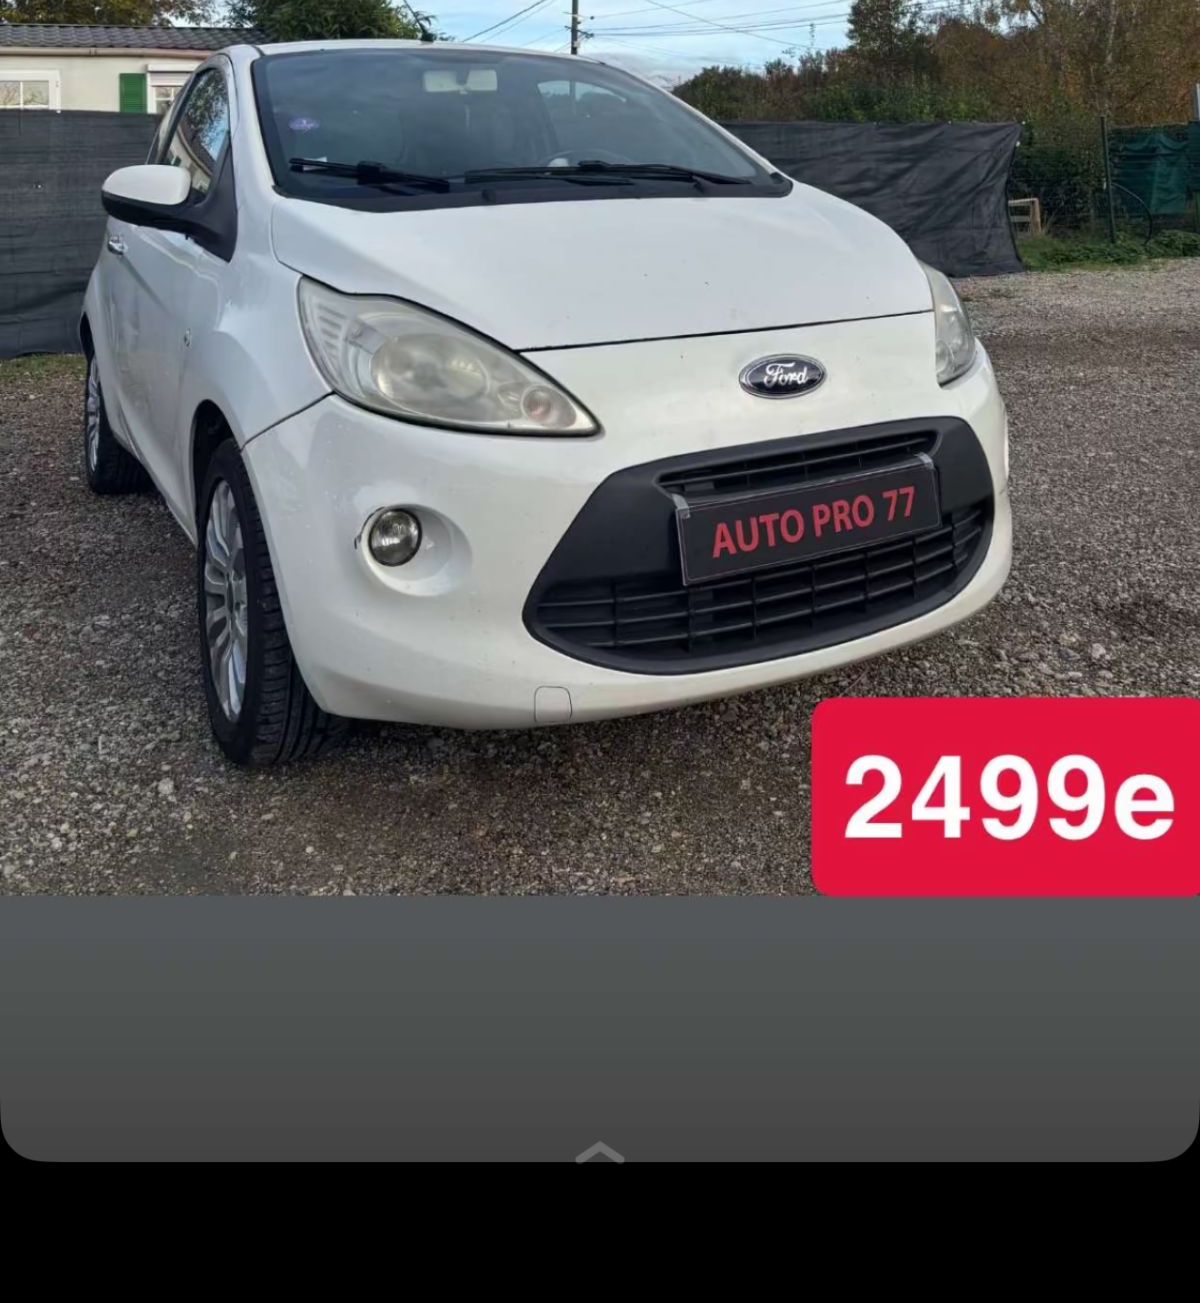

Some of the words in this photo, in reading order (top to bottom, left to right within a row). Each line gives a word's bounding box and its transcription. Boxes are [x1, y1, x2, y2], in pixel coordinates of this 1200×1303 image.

[763, 361, 809, 388] Ford
[712, 509, 804, 558] AUTO
[812, 495, 874, 537] PRO
[882, 486, 915, 521] 77
